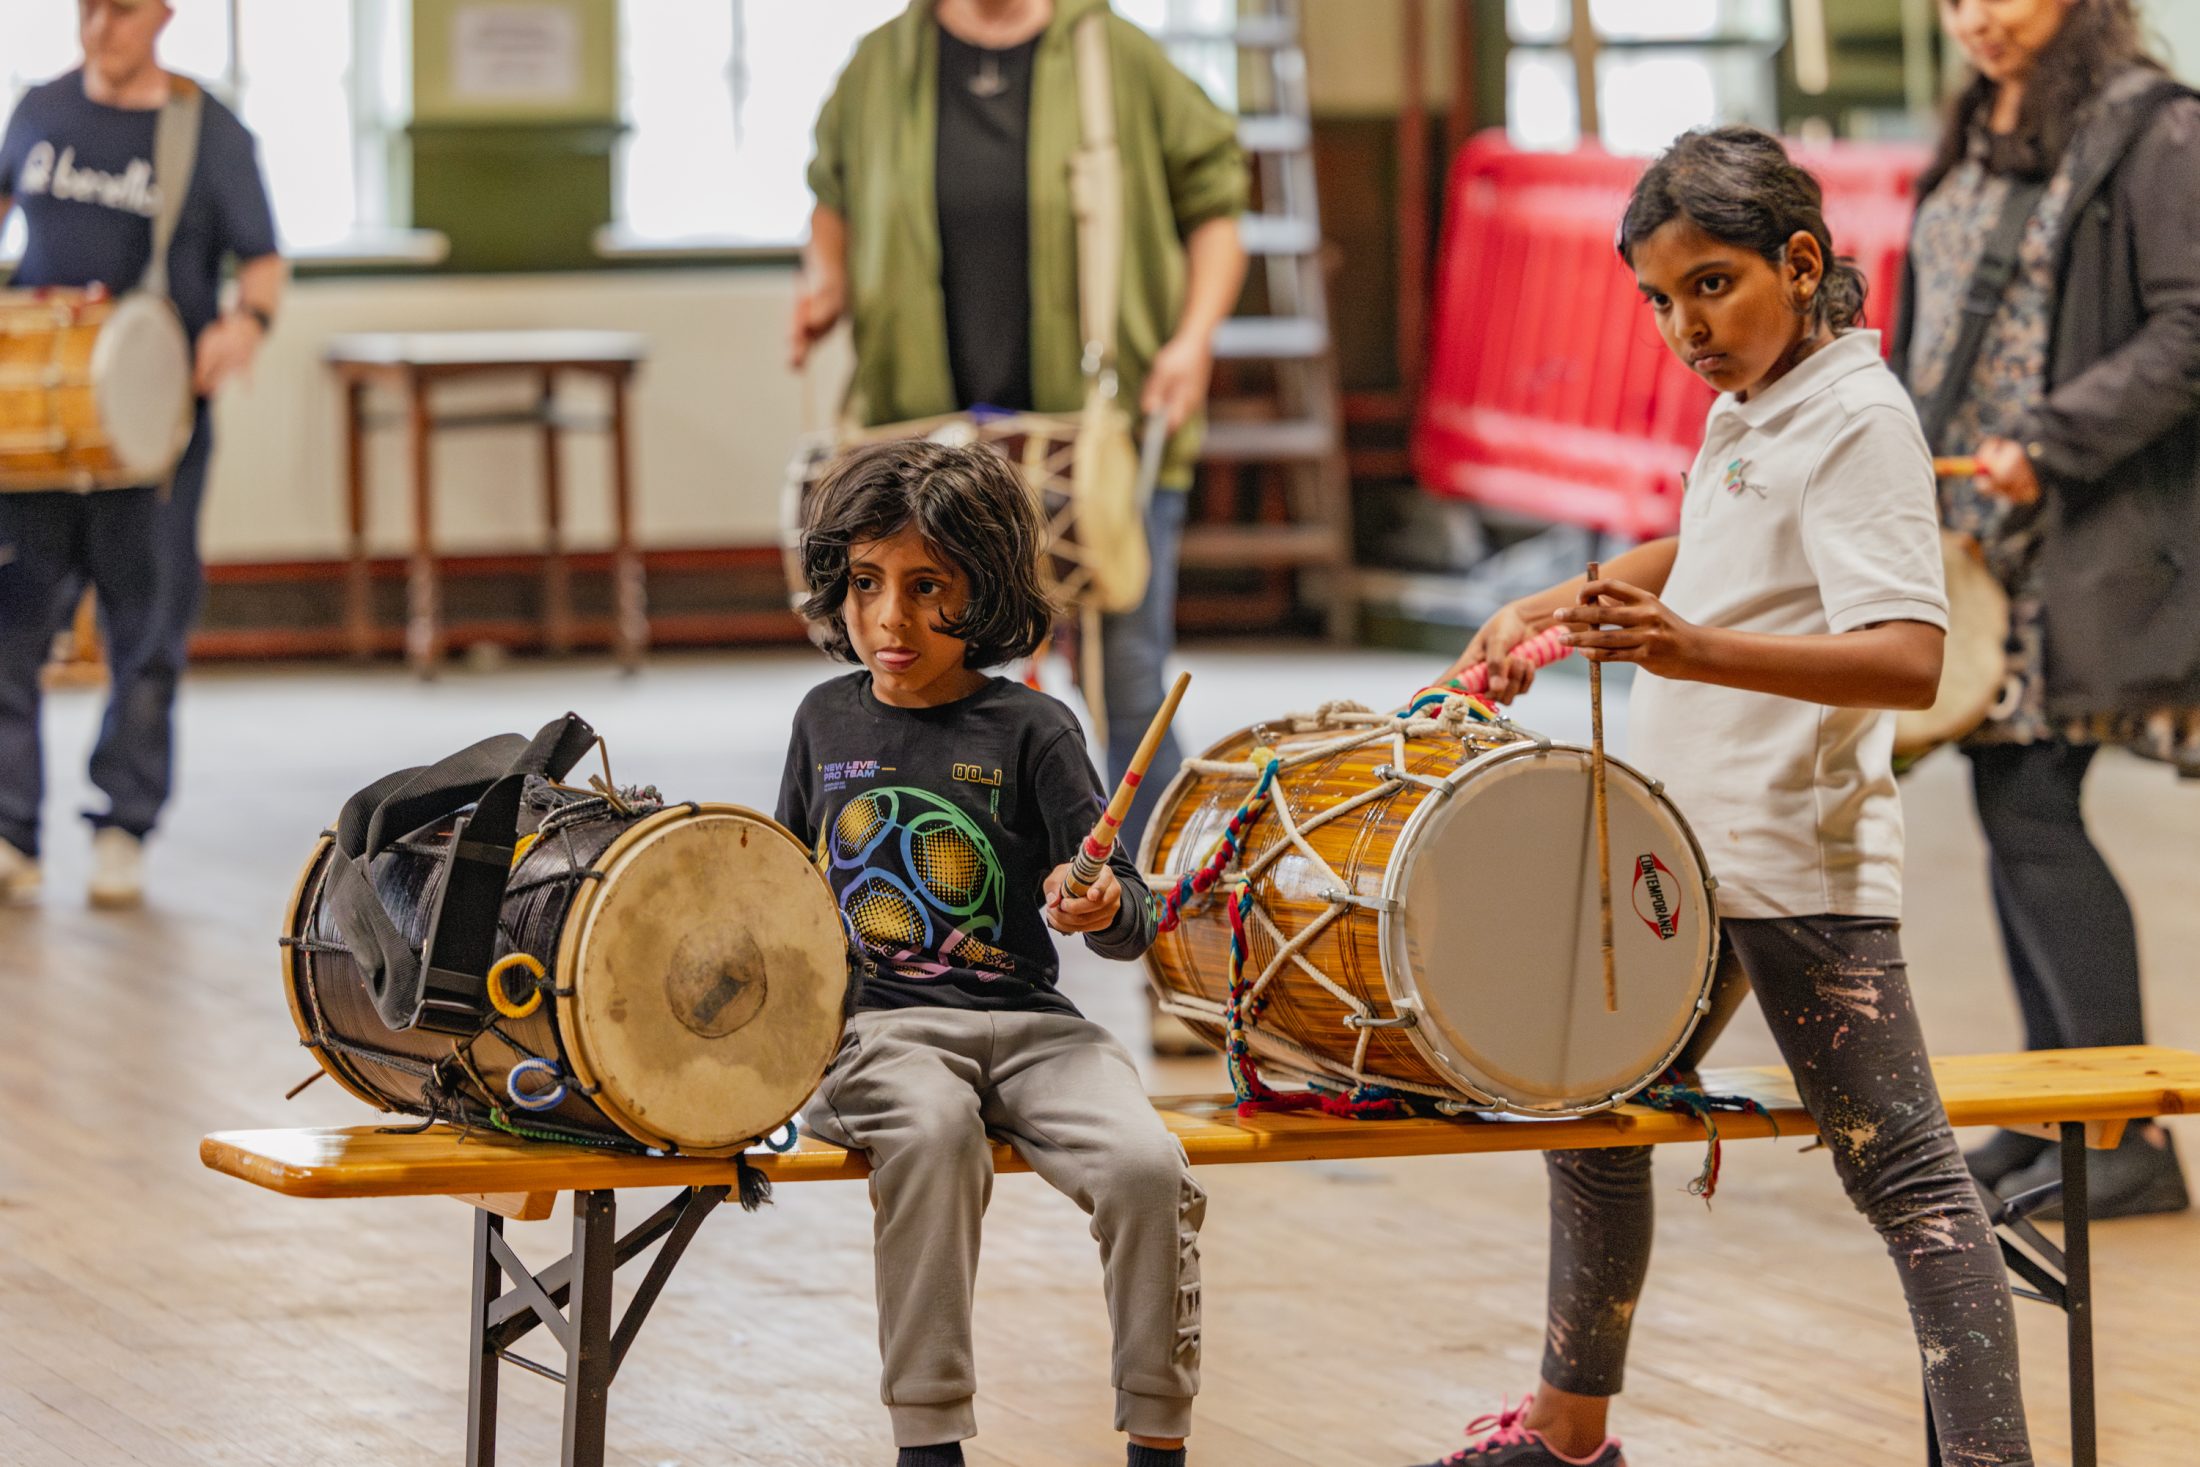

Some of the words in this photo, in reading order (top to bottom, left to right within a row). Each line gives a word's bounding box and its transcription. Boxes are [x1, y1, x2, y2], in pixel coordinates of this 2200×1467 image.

[824, 762, 845, 773] NEW
[846, 760, 880, 770] LEVEL
[823, 771, 841, 782] PRO
[844, 769, 875, 779] TEAM
